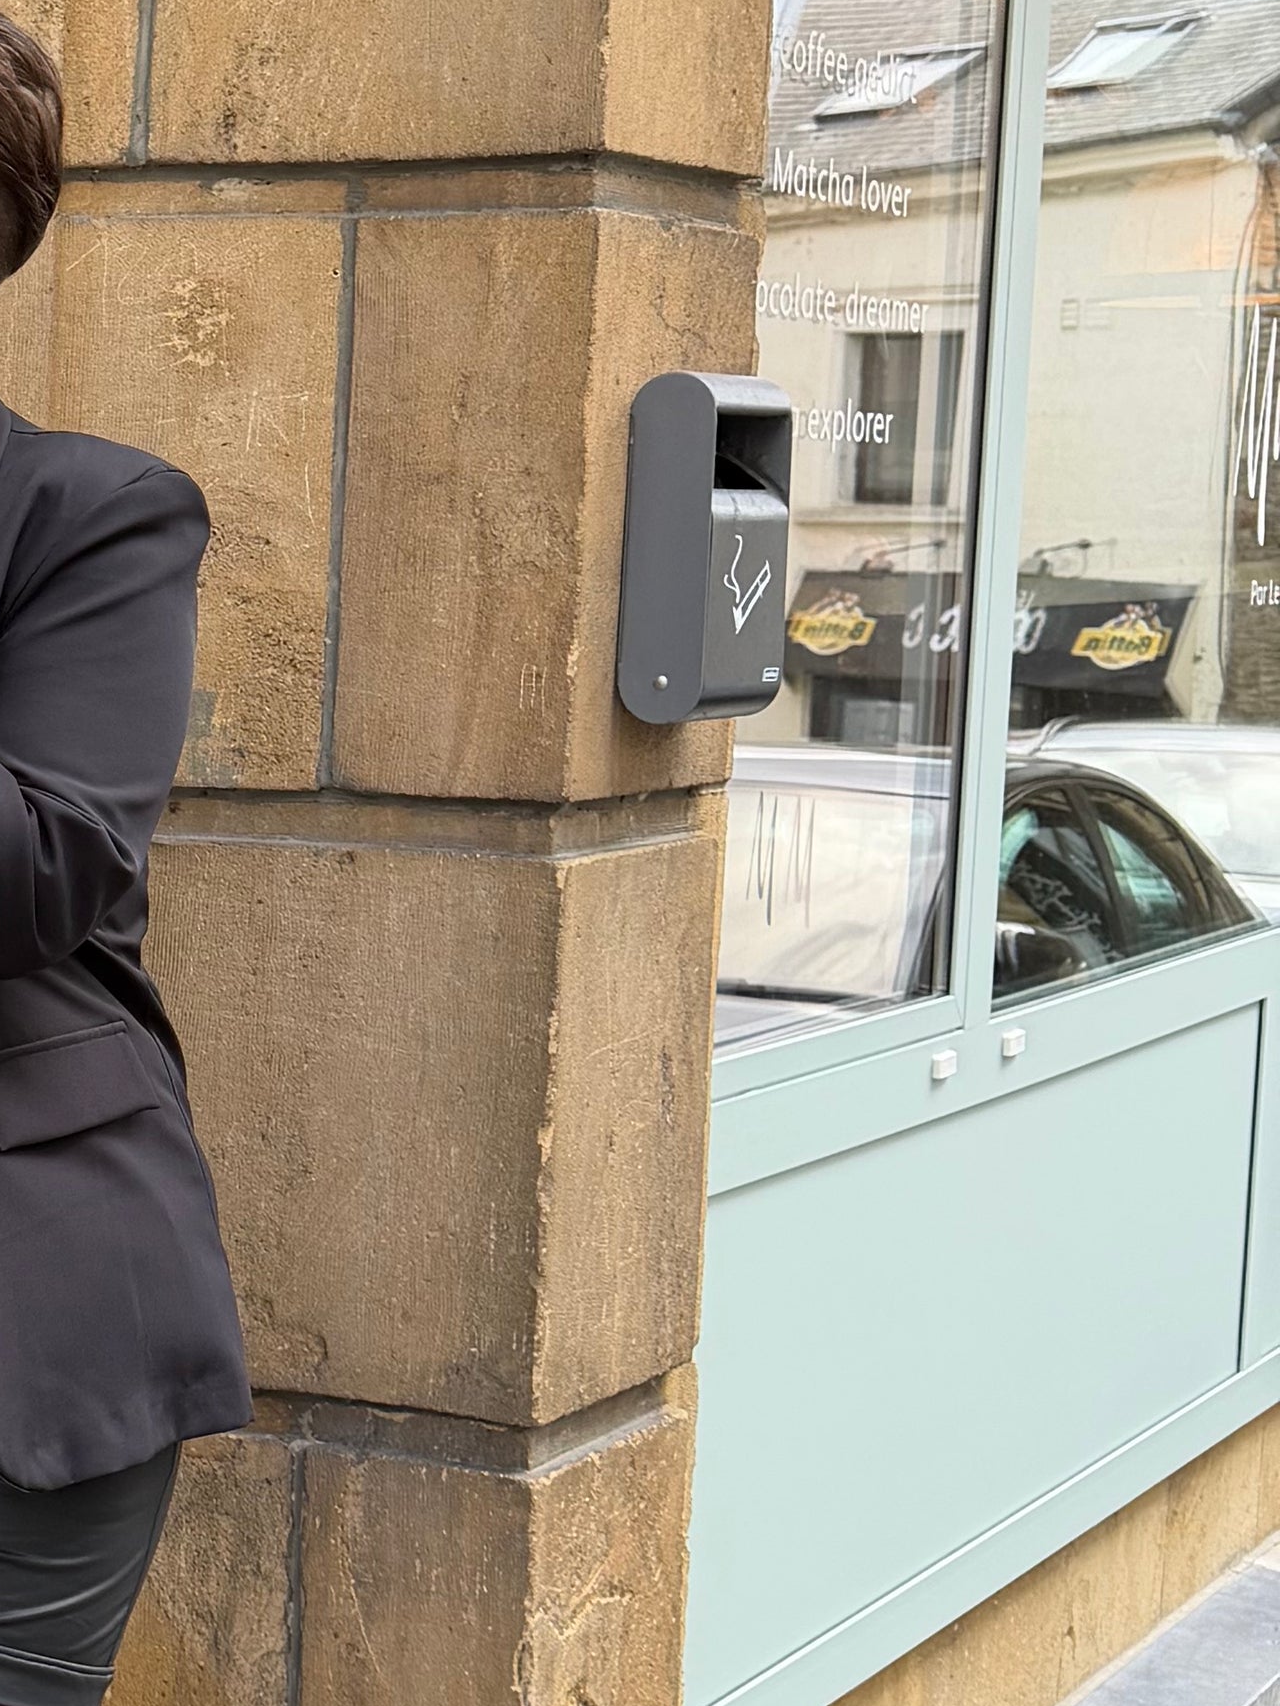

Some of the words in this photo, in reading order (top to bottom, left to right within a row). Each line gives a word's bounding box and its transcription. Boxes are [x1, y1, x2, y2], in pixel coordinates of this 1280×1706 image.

[772, 146, 855, 207] Matcha
[861, 164, 913, 218] lover
[755, 271, 836, 322] ocolate
[844, 280, 930, 334] dreamer
[807, 397, 894, 453] explorer
